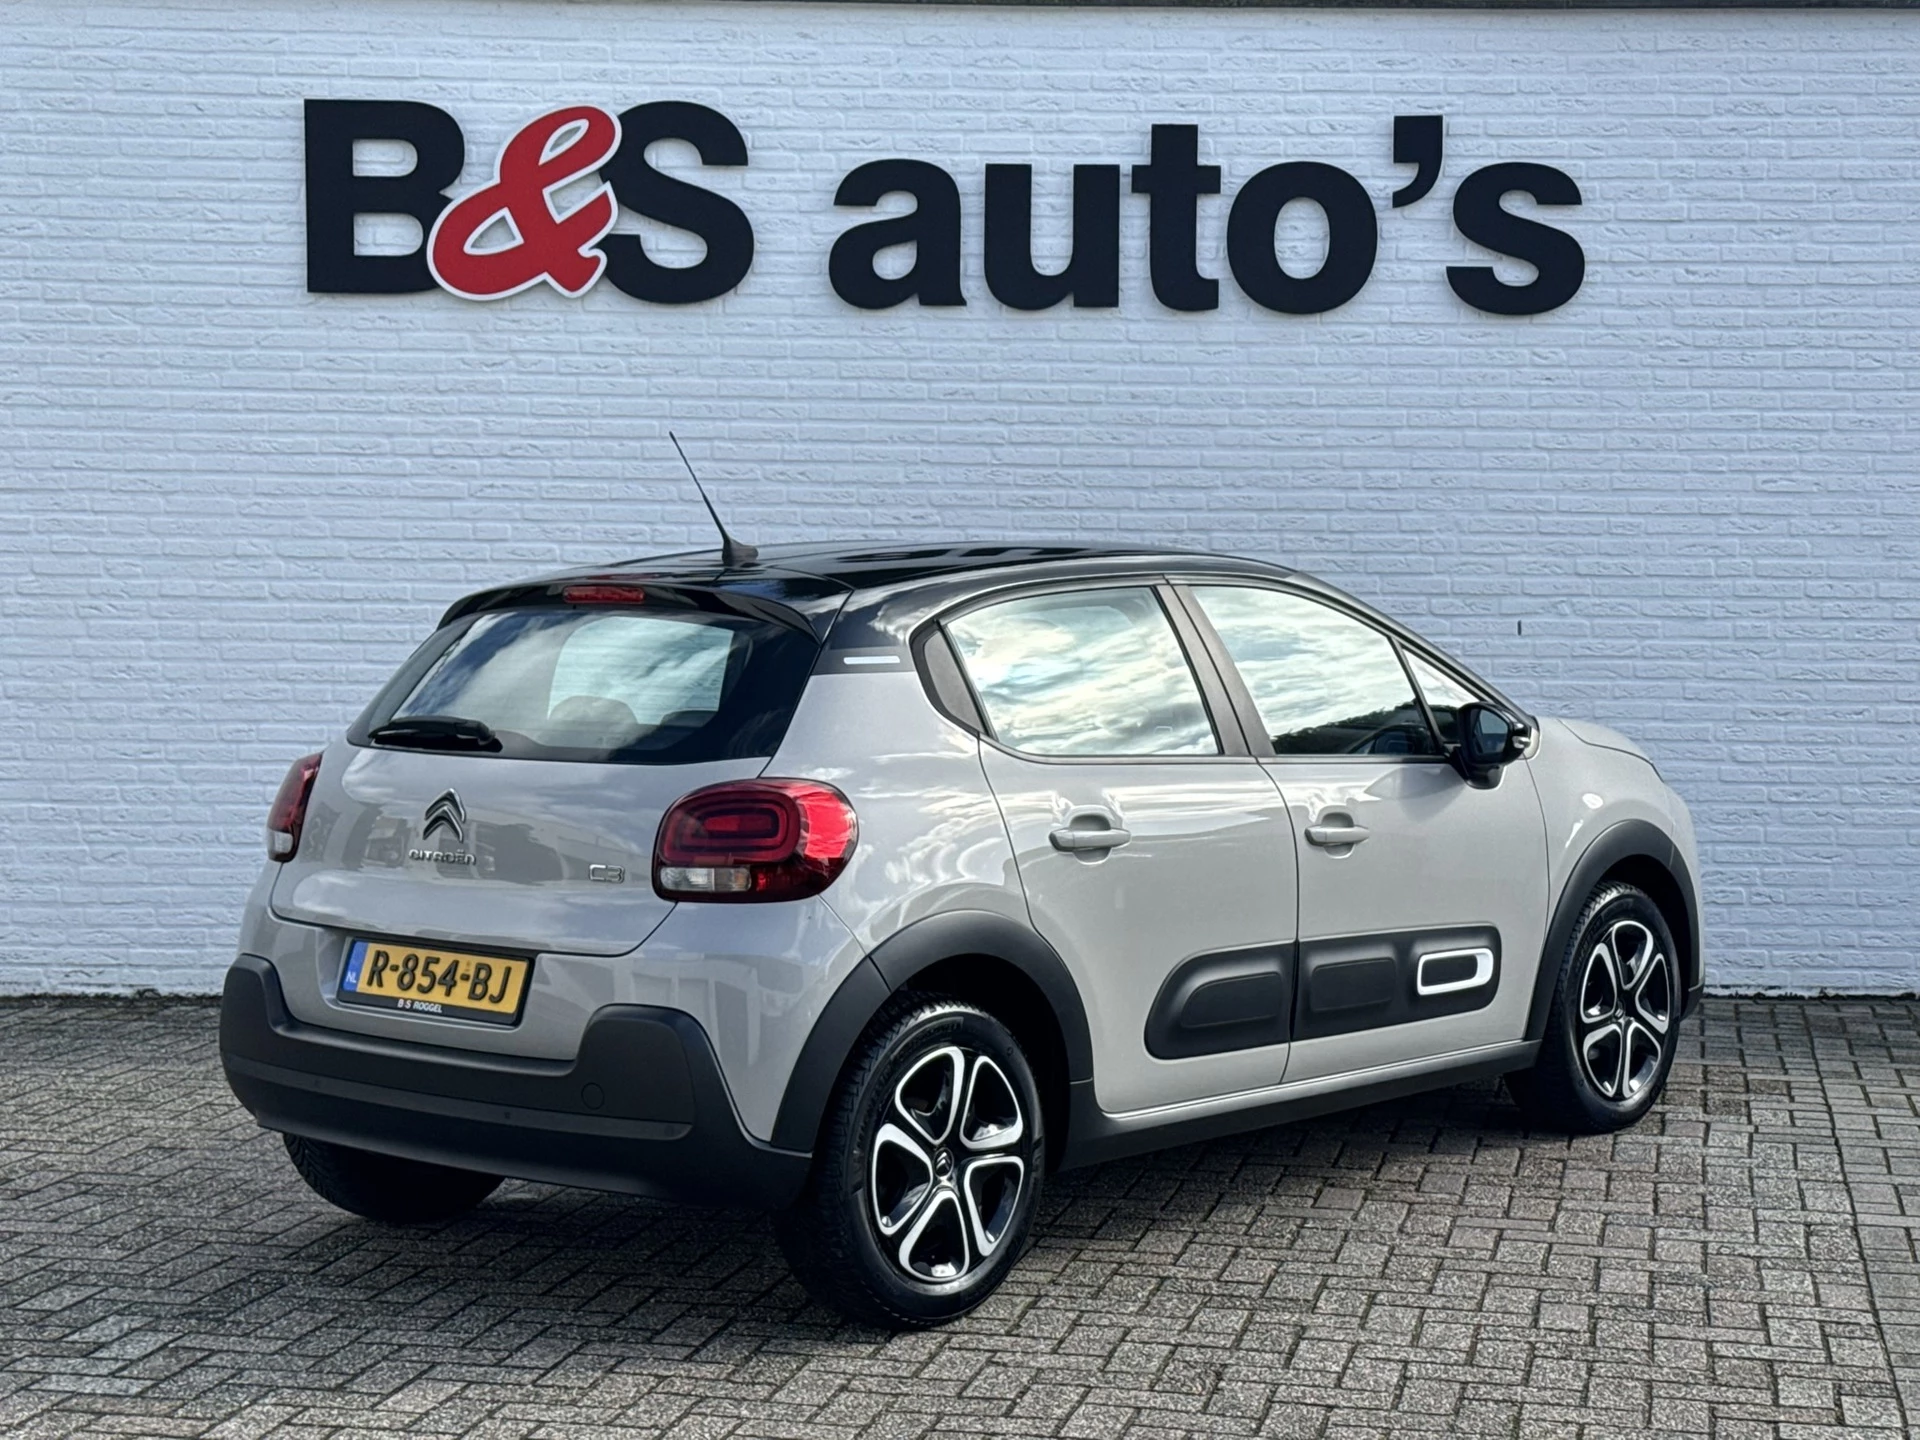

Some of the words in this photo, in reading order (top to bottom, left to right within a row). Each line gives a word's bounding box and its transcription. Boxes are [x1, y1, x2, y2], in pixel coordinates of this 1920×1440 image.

[303, 98, 756, 306] B&S
[828, 114, 1586, 317] auto's
[589, 864, 625, 883] C3
[345, 971, 357, 983] NL
[366, 950, 512, 1004] R-854-BJ
[405, 1000, 412, 1009] S
[412, 1002, 443, 1013] ROGGEL
